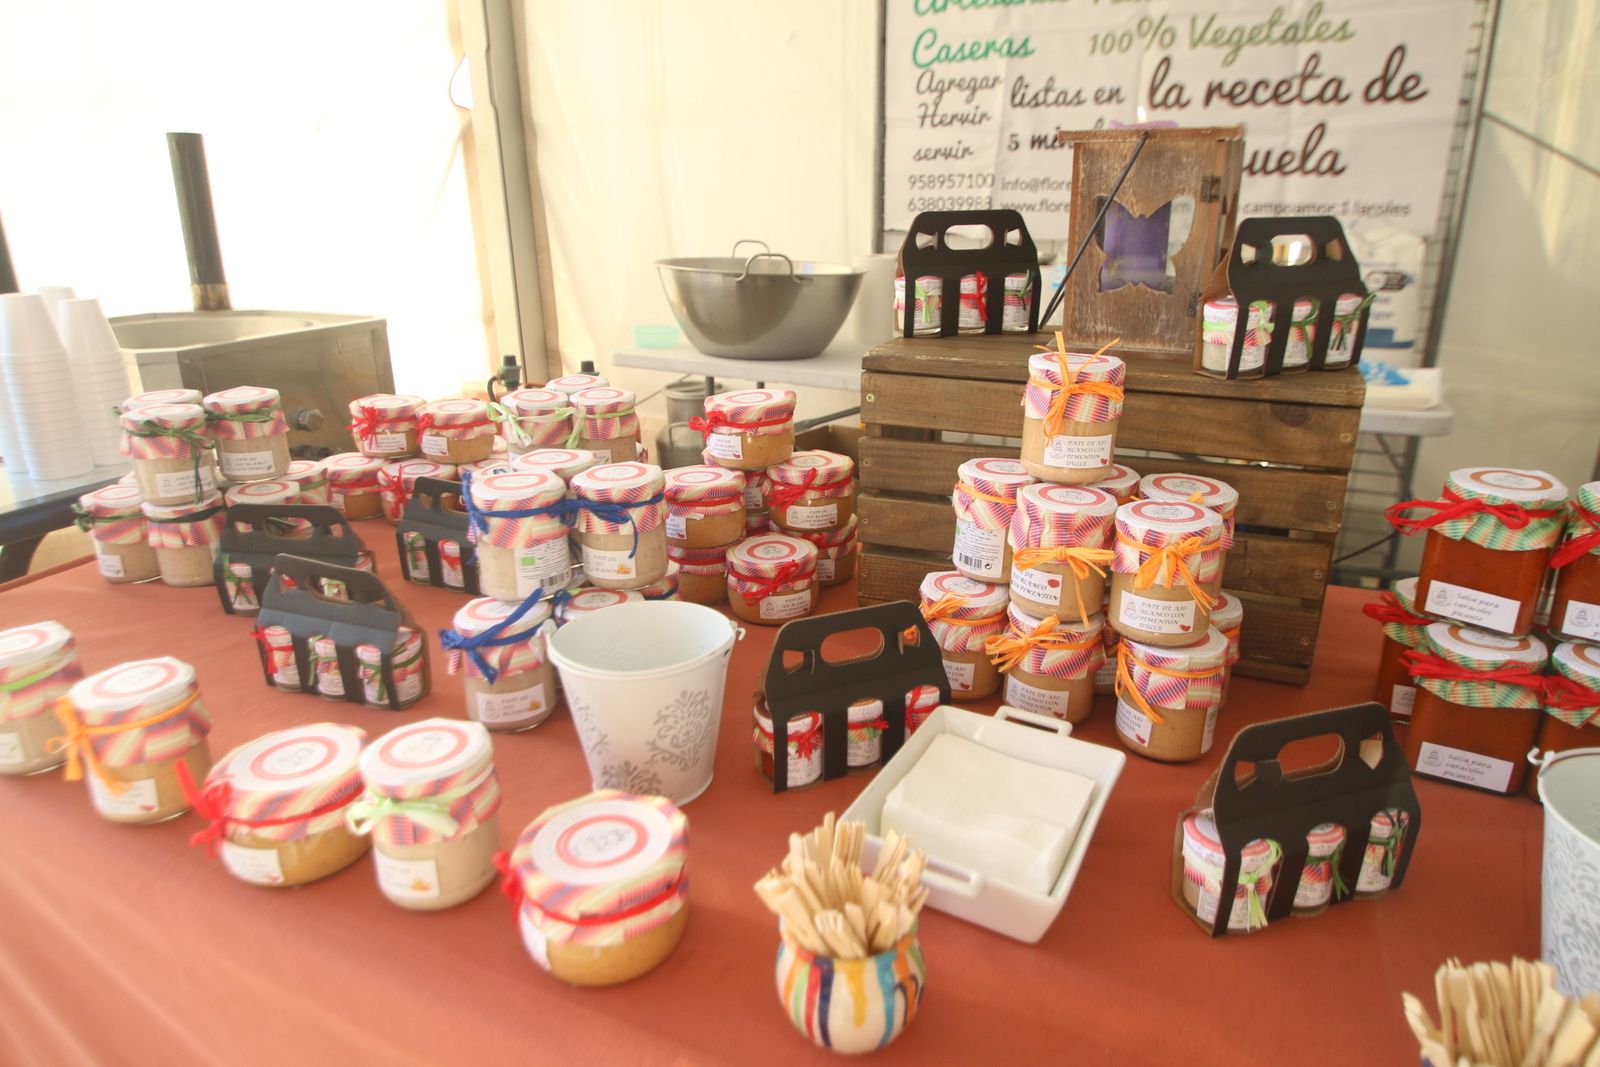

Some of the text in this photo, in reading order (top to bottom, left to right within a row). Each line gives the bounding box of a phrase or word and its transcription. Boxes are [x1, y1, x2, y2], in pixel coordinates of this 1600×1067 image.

[912, 27, 1036, 68] Caseras
[1089, 1, 1358, 67] 100% Vegetales
[916, 69, 1002, 104] Agregar
[1010, 75, 1126, 108] listas en
[1148, 44, 1430, 110] la receta de
[918, 102, 992, 130] Hervir
[912, 140, 974, 162] servir
[1008, 133, 1019, 152] 5
[1242, 122, 1347, 177] uela
[907, 172, 996, 191] 958957100
[1141, 602, 1160, 610] PATE
